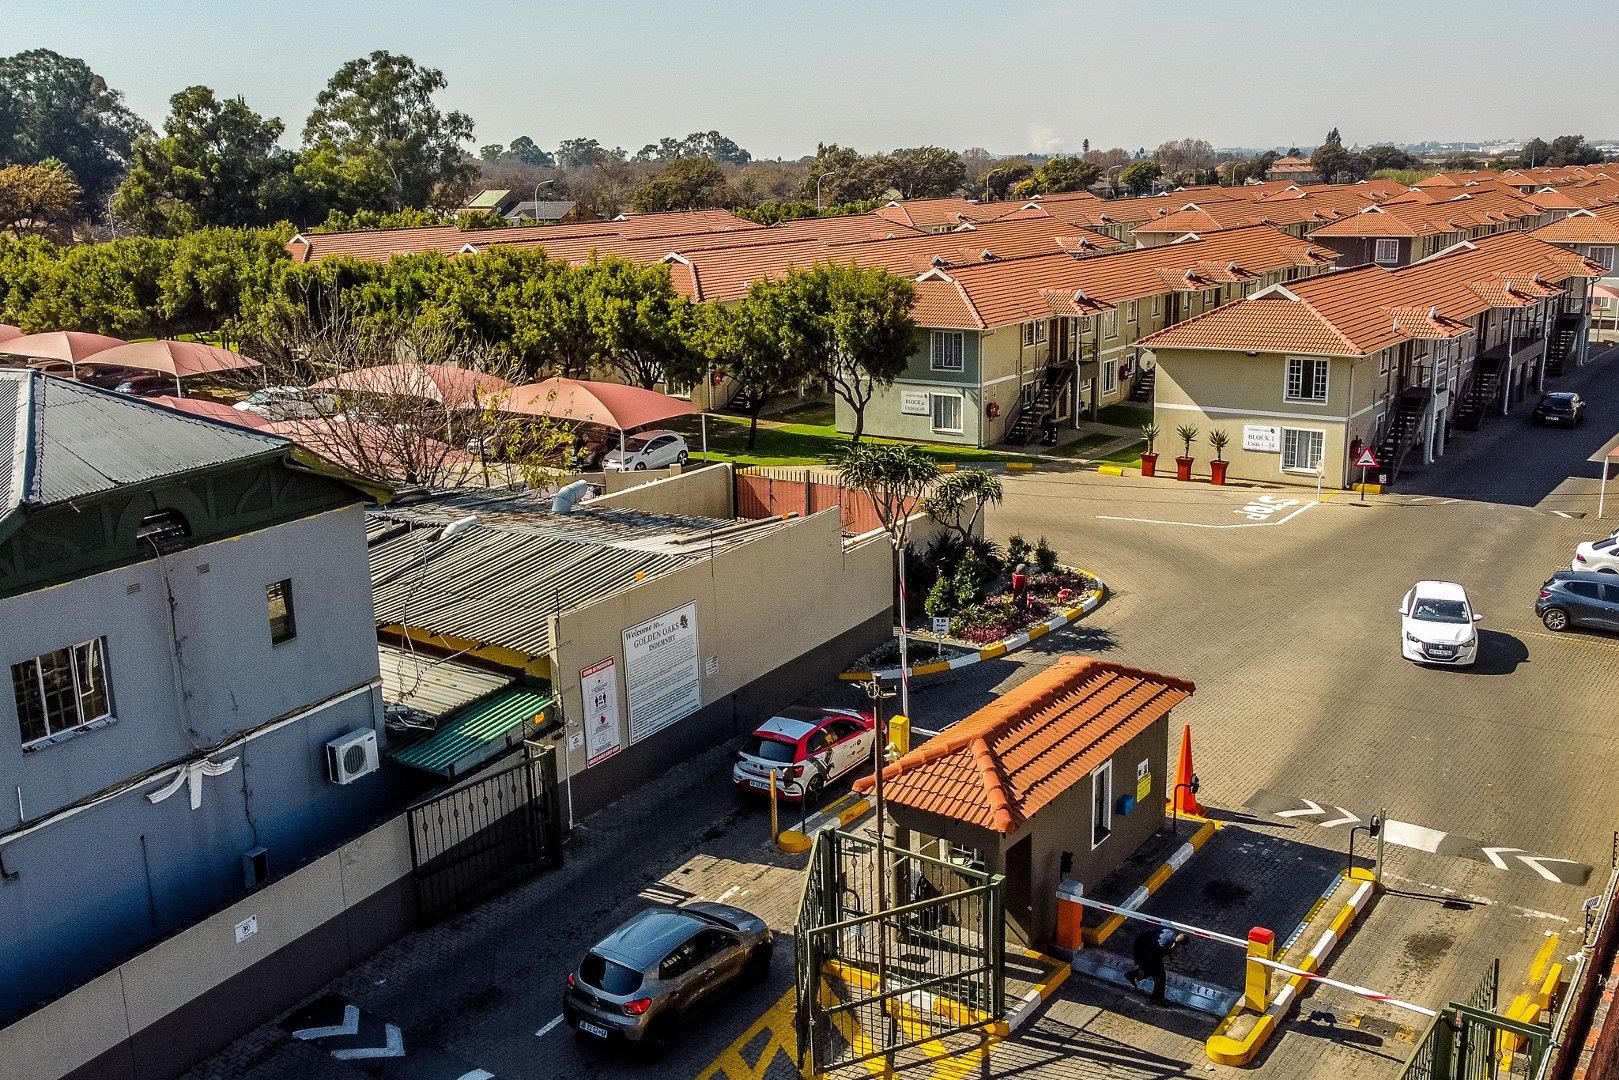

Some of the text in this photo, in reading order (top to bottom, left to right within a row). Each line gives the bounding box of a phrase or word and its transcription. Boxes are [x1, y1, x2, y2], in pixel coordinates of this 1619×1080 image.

[1248, 434, 1270, 442] BLOCK
[625, 623, 653, 641] Welcome
[633, 622, 680, 649] GOLDEN OAKS
